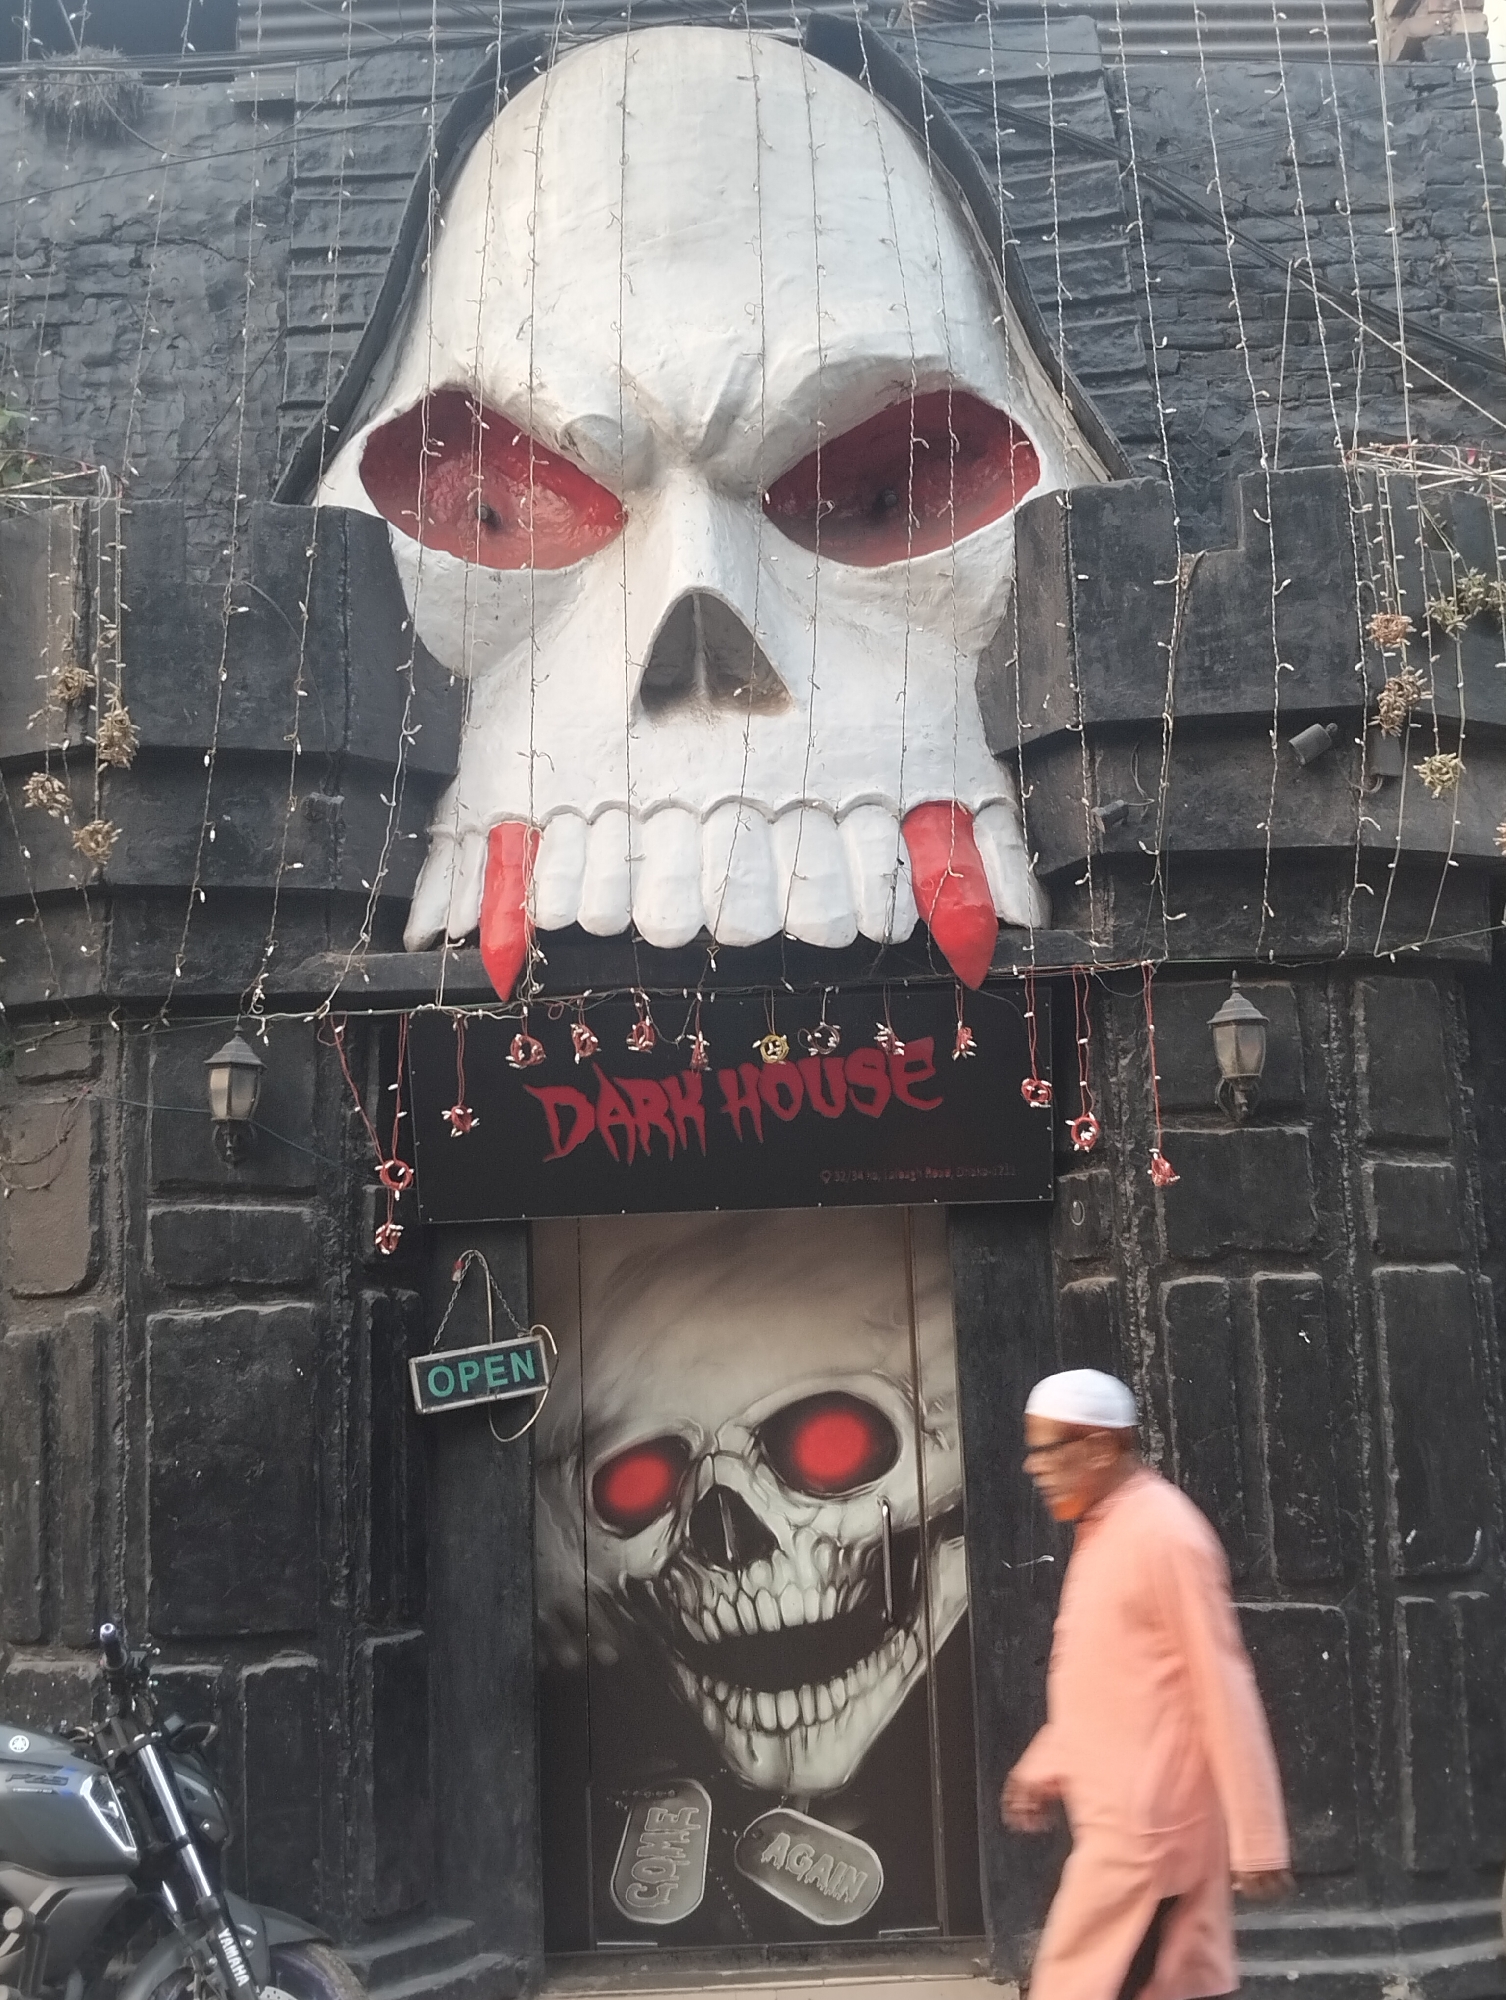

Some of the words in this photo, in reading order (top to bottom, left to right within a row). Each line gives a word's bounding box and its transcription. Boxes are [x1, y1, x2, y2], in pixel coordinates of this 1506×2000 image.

[523, 1061, 706, 1165] DARK
[718, 1037, 943, 1143] HOUSE
[427, 1349, 536, 1398] OPEN
[625, 1806, 702, 1909] COME
[760, 1832, 868, 1904] AGAIN
[217, 1927, 250, 1988] YAMAHA
